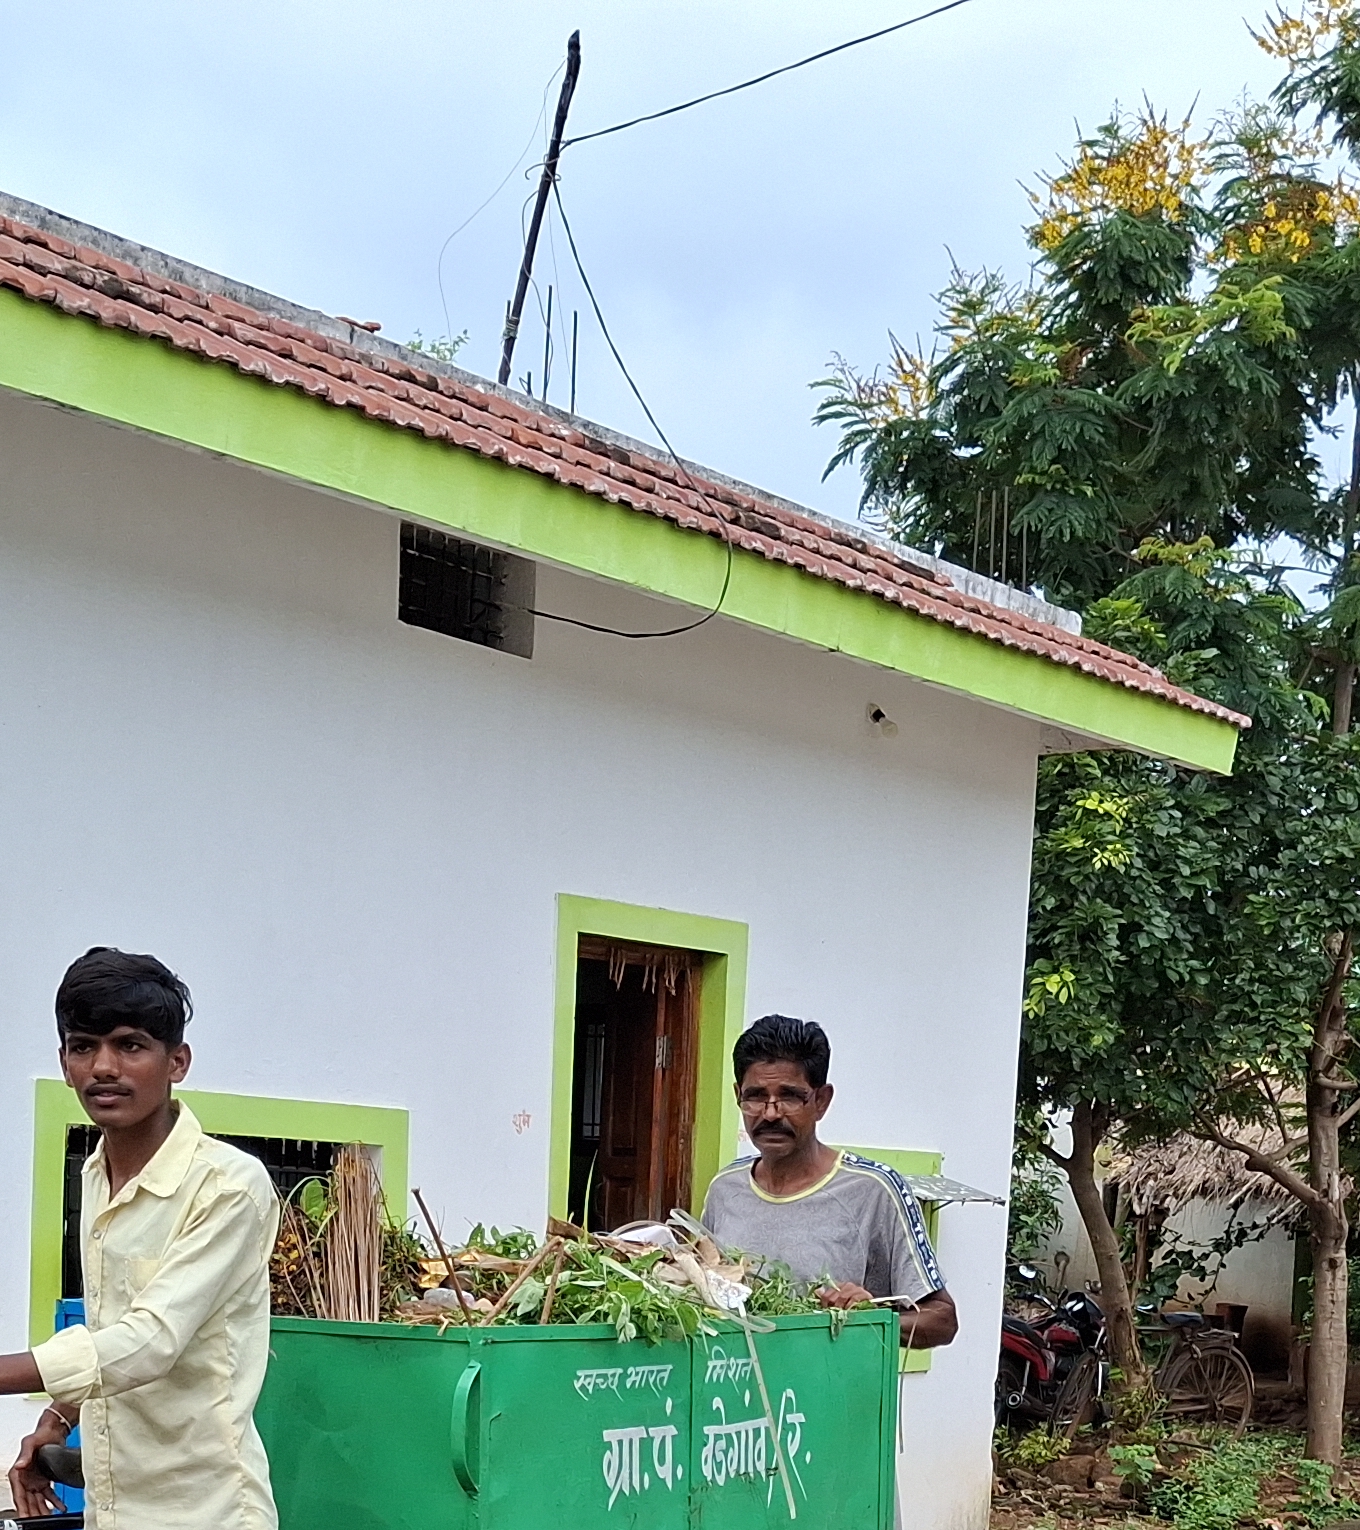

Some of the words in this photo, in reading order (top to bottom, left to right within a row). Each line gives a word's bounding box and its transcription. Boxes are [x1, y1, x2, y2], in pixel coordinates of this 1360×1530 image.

[573, 1368, 623, 1401] स्वच्छ
[626, 1364, 673, 1398] भारत
[705, 1345, 752, 1395] मिशन
